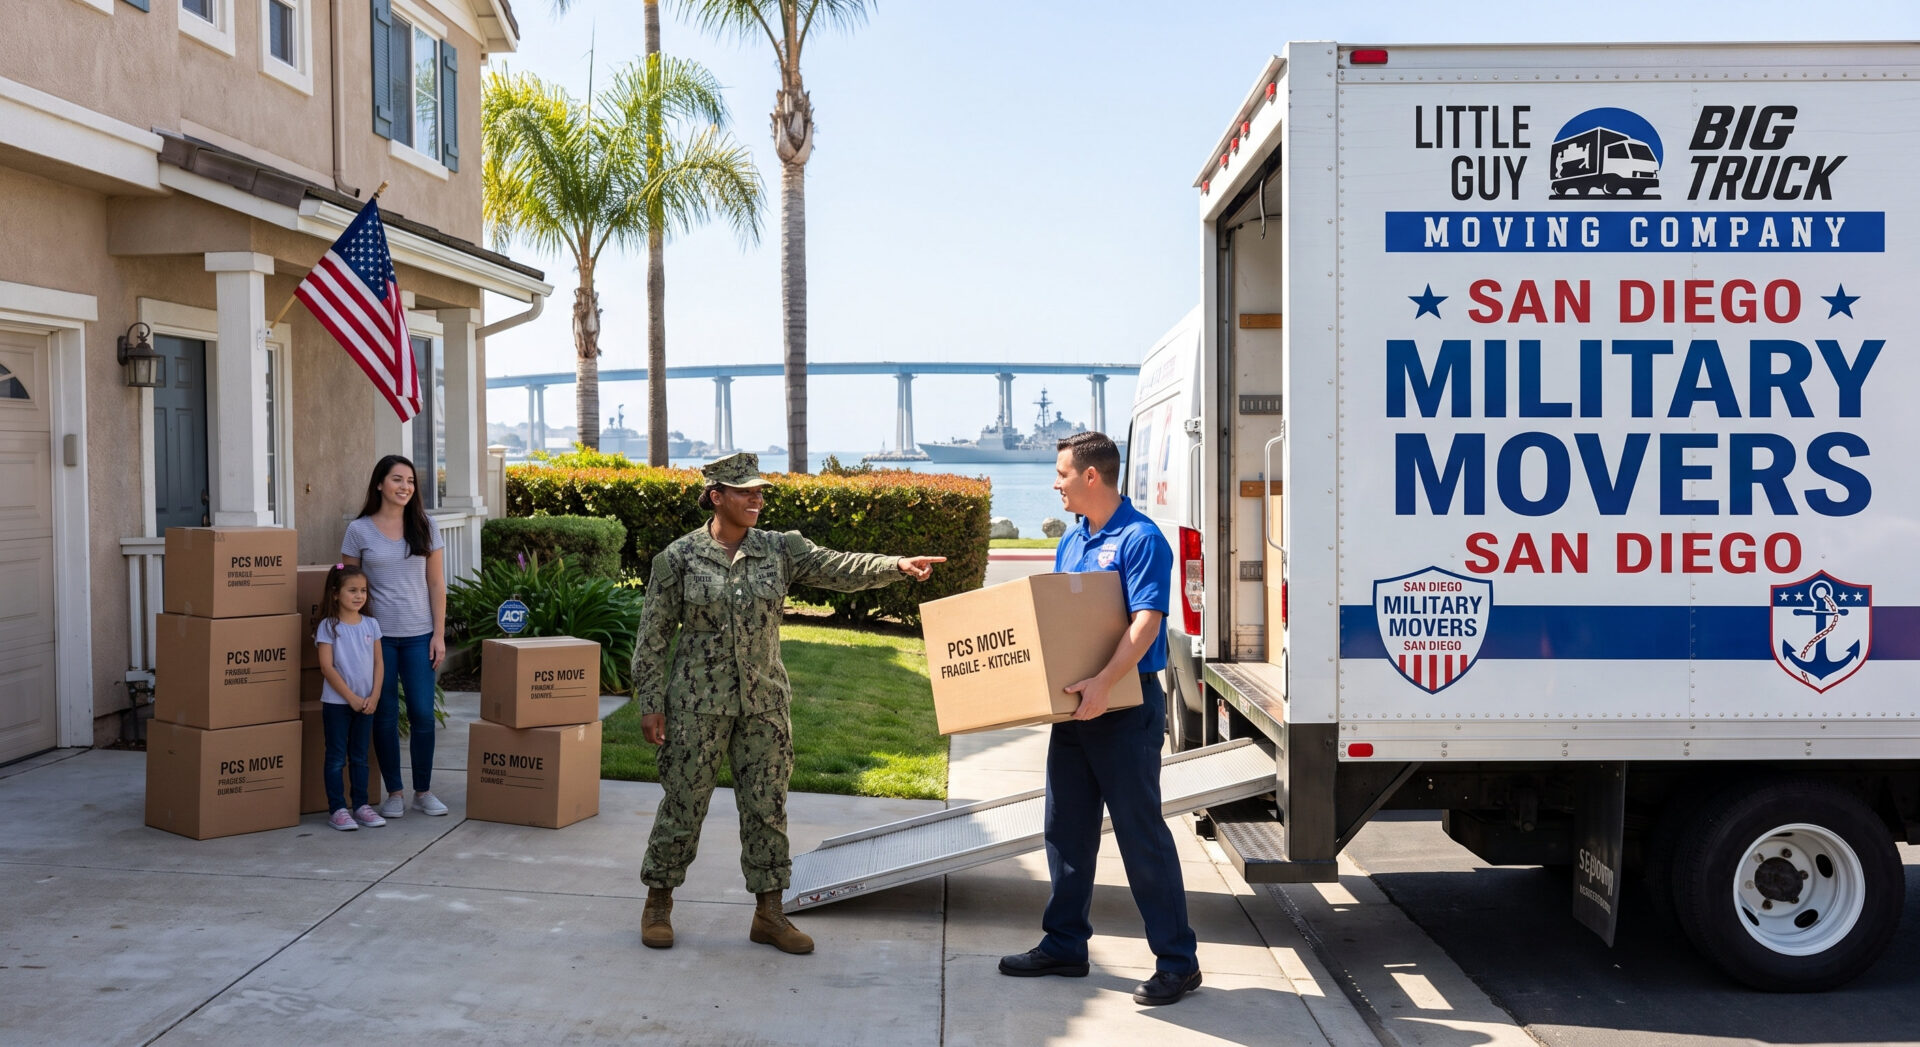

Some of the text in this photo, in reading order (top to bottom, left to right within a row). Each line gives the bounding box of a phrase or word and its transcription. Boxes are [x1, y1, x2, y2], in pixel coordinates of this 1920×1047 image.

[1415, 105, 1531, 149] LITTLE
[1688, 105, 1798, 151] BIG
[1451, 155, 1528, 201] GUY
[1686, 155, 1848, 201] TRUCK
[1424, 216, 1846, 248] MOVING COMPANY
[1468, 278, 1802, 324] SAN DIEGO
[1386, 339, 1887, 418] MILITARY
[1395, 431, 1872, 517] MOVERS
[231, 555, 283, 568] PCS MOVE
[1464, 531, 1802, 575] SAN DIEGO
[1403, 581, 1463, 592] SAN DIEGO
[1383, 595, 1483, 615] MILITARY
[1389, 617, 1478, 637] MOVERS
[227, 647, 287, 665] PCS MOVE
[947, 628, 1016, 659] PCS MOVE
[1403, 640, 1462, 651] SAN DIEGO
[534, 668, 585, 682] PCS MOVE
[941, 659, 980, 679] FRAGILE
[988, 649, 1031, 669] KITCHEN
[220, 755, 284, 775] PCS MOVE
[483, 751, 544, 770] PCS MOVE
